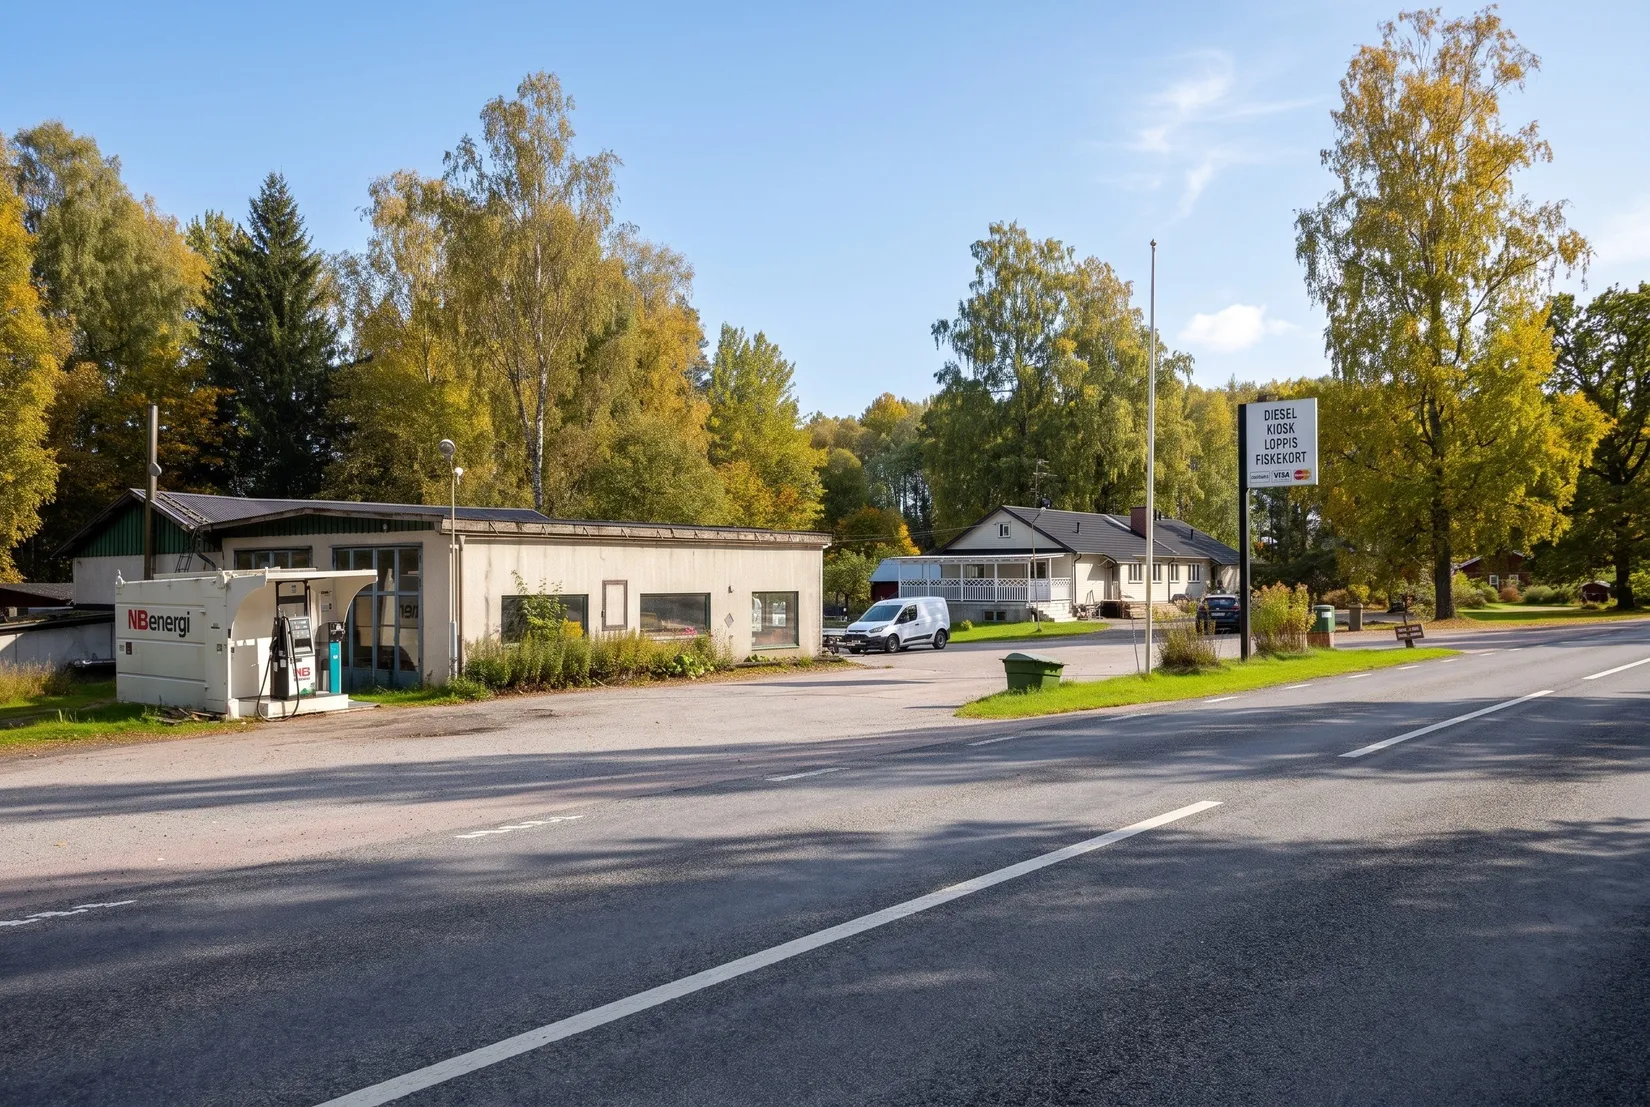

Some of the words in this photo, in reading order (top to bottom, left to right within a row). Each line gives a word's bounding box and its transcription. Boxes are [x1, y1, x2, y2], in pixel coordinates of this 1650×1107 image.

[1264, 408, 1297, 421] DIESEL
[1267, 422, 1295, 435] KIOSK
[1265, 437, 1298, 450] LOPPIS
[1256, 451, 1307, 465] FISKEKORT
[1273, 471, 1290, 479] VISA
[293, 667, 311, 677] NB
